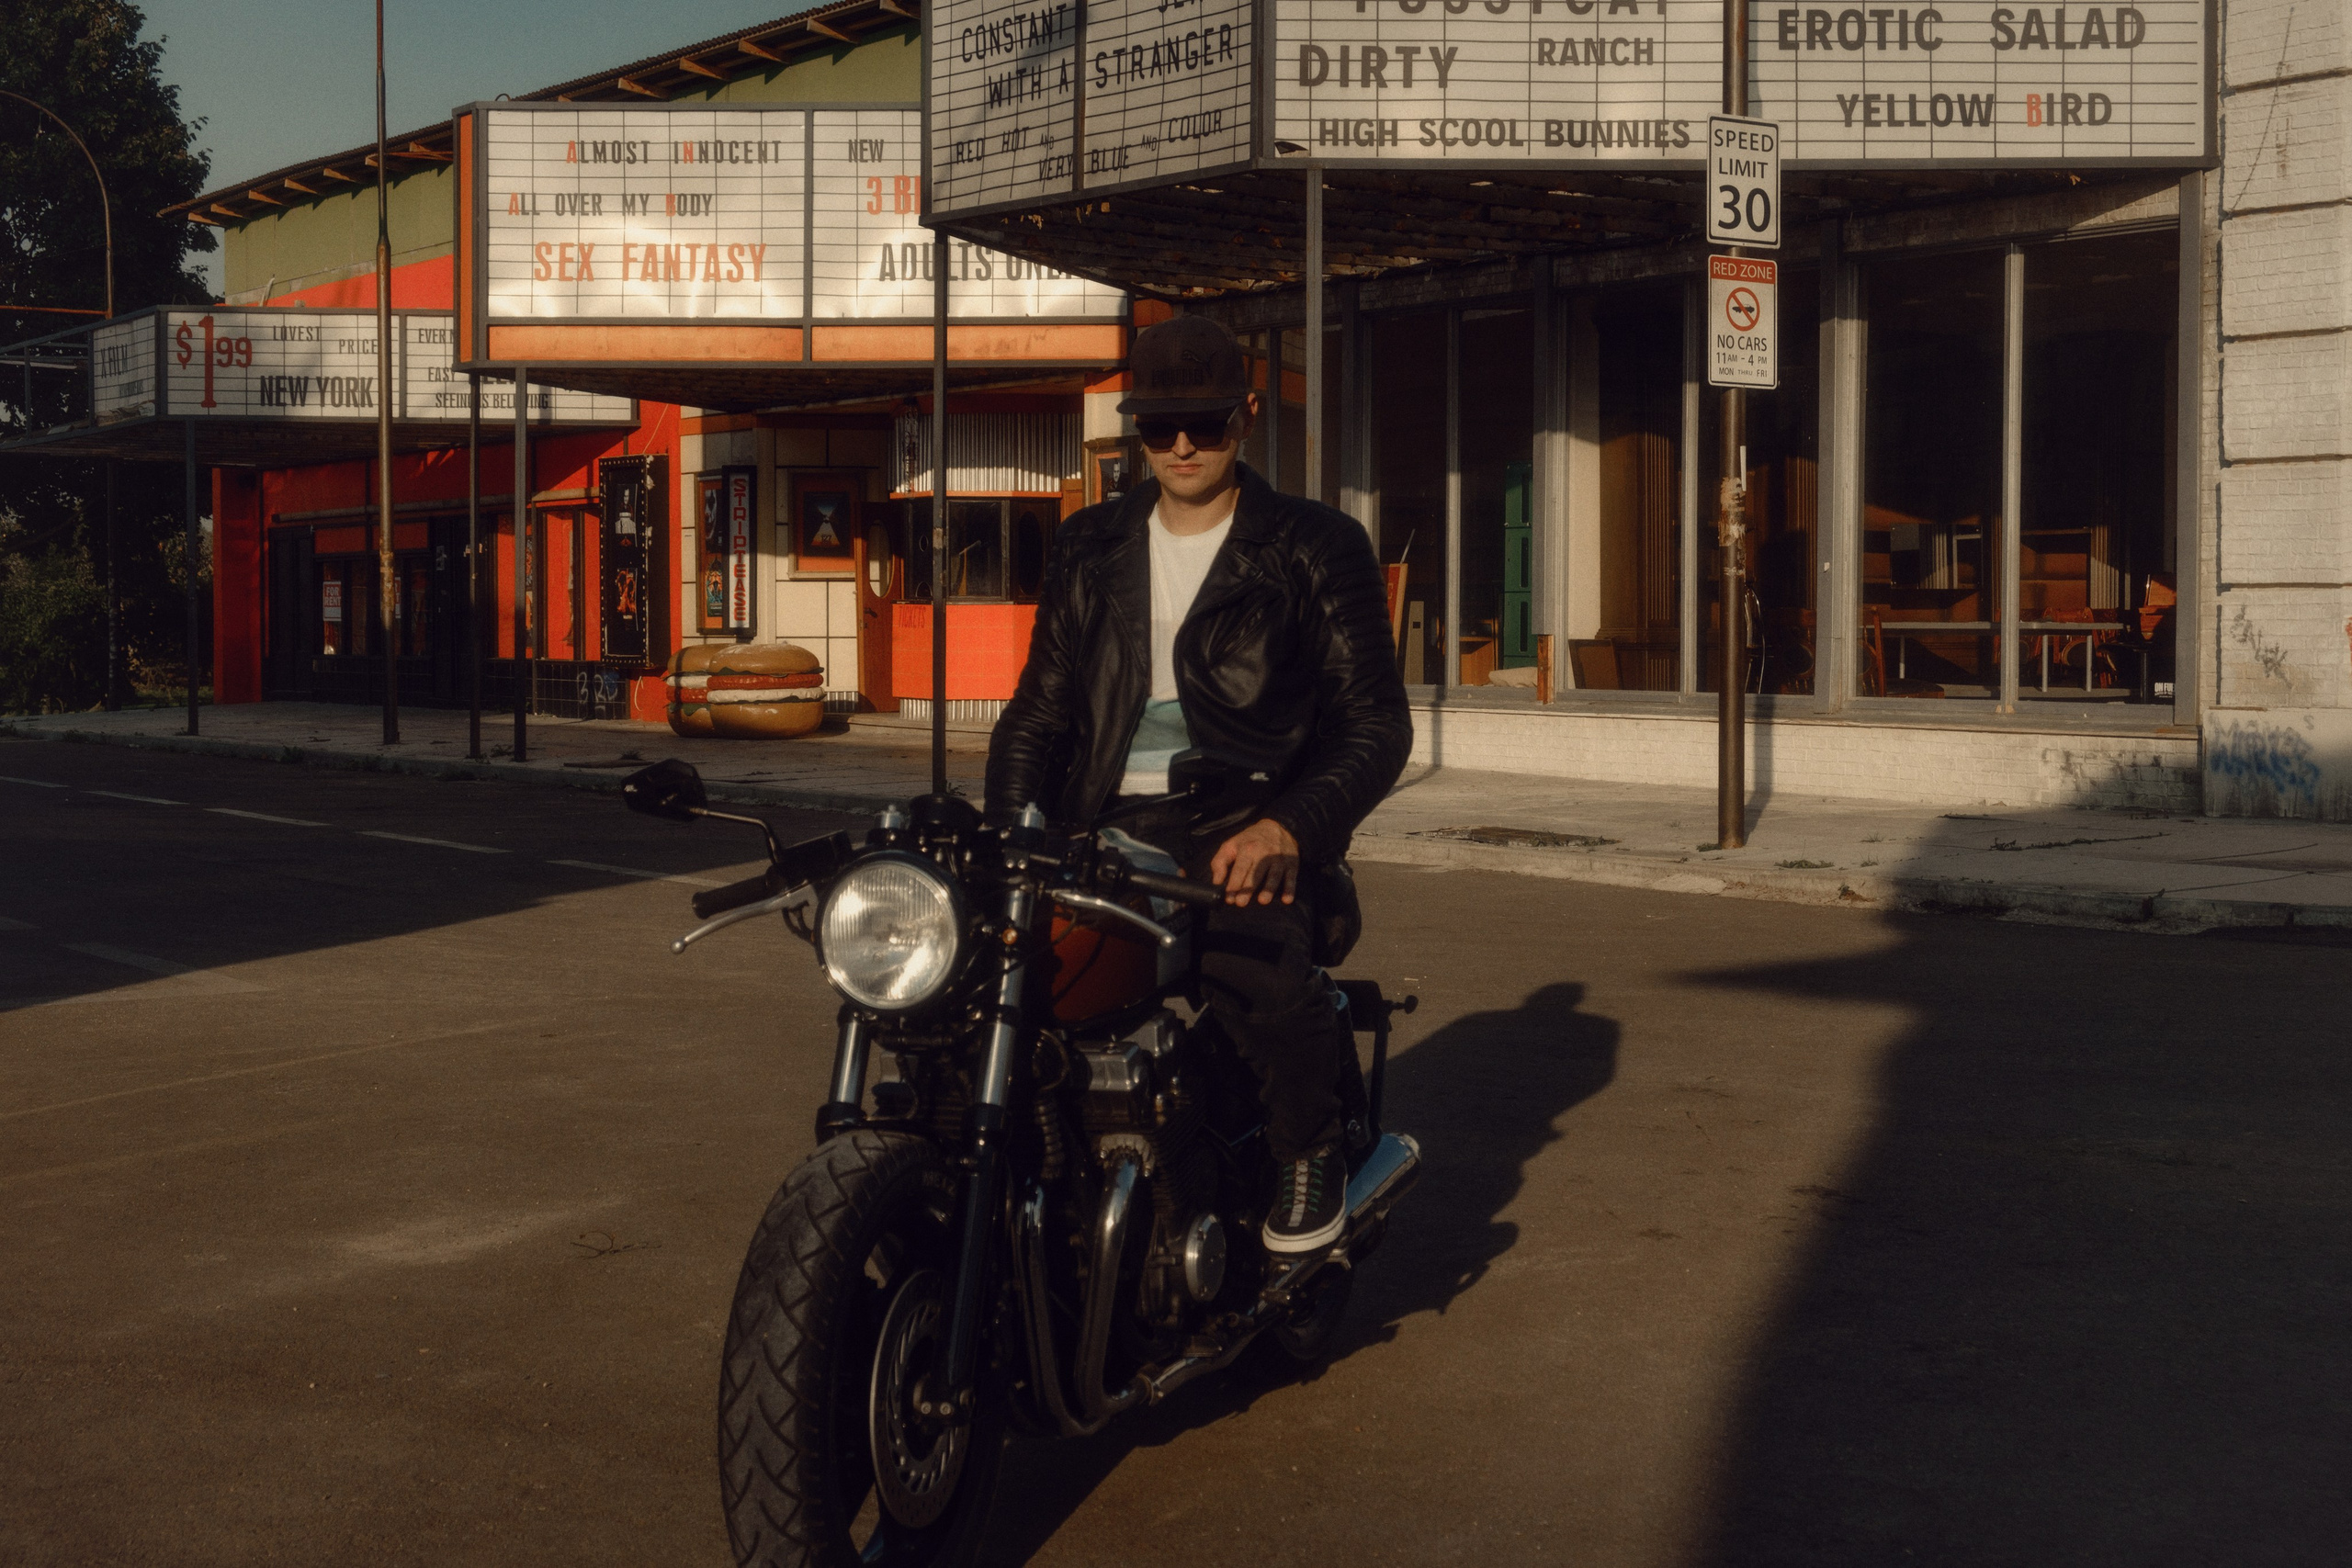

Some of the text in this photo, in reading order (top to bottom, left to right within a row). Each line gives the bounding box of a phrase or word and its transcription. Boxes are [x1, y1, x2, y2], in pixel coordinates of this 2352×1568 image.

[962, 4, 1067, 62] CONSTANT
[1778, 7, 2146, 51] EROTIC SALAD
[989, 24, 1233, 109] WITH A STRANGER
[1298, 44, 1459, 89] DIRTY
[1537, 37, 1654, 67] RANCH
[1836, 93, 2113, 128] YELLOW BIRD
[956, 127, 1055, 165] RED HOT AND
[1038, 109, 1223, 182] VERY BLUE AND COLOR
[1319, 118, 1690, 149] HIGH SCOOL BUNNIES
[1713, 129, 1774, 152] SPEED
[567, 141, 782, 164] ALMOST INNOCENT
[848, 139, 884, 163] NEW
[1718, 157, 1769, 178] LIMIT
[508, 193, 712, 217] ALL OVER MY BODY
[867, 176, 883, 215] 3
[1717, 185, 1770, 233] 30
[534, 242, 766, 282] SEX FANTASY
[1713, 261, 1773, 280] RED ZONE
[418, 328, 446, 344] EVER
[1717, 334, 1768, 352] NO CARS
[100, 343, 128, 378] X FILM
[1718, 367, 1735, 376] MON
[1757, 368, 1768, 378] FRI
[1747, 354, 1754, 367] 4
[1758, 355, 1768, 365] PM
[260, 375, 373, 408] NEW YORK
[733, 479, 747, 622] STRIPTEASE
[324, 596, 342, 606] RENT
[326, 586, 339, 597] FOR
